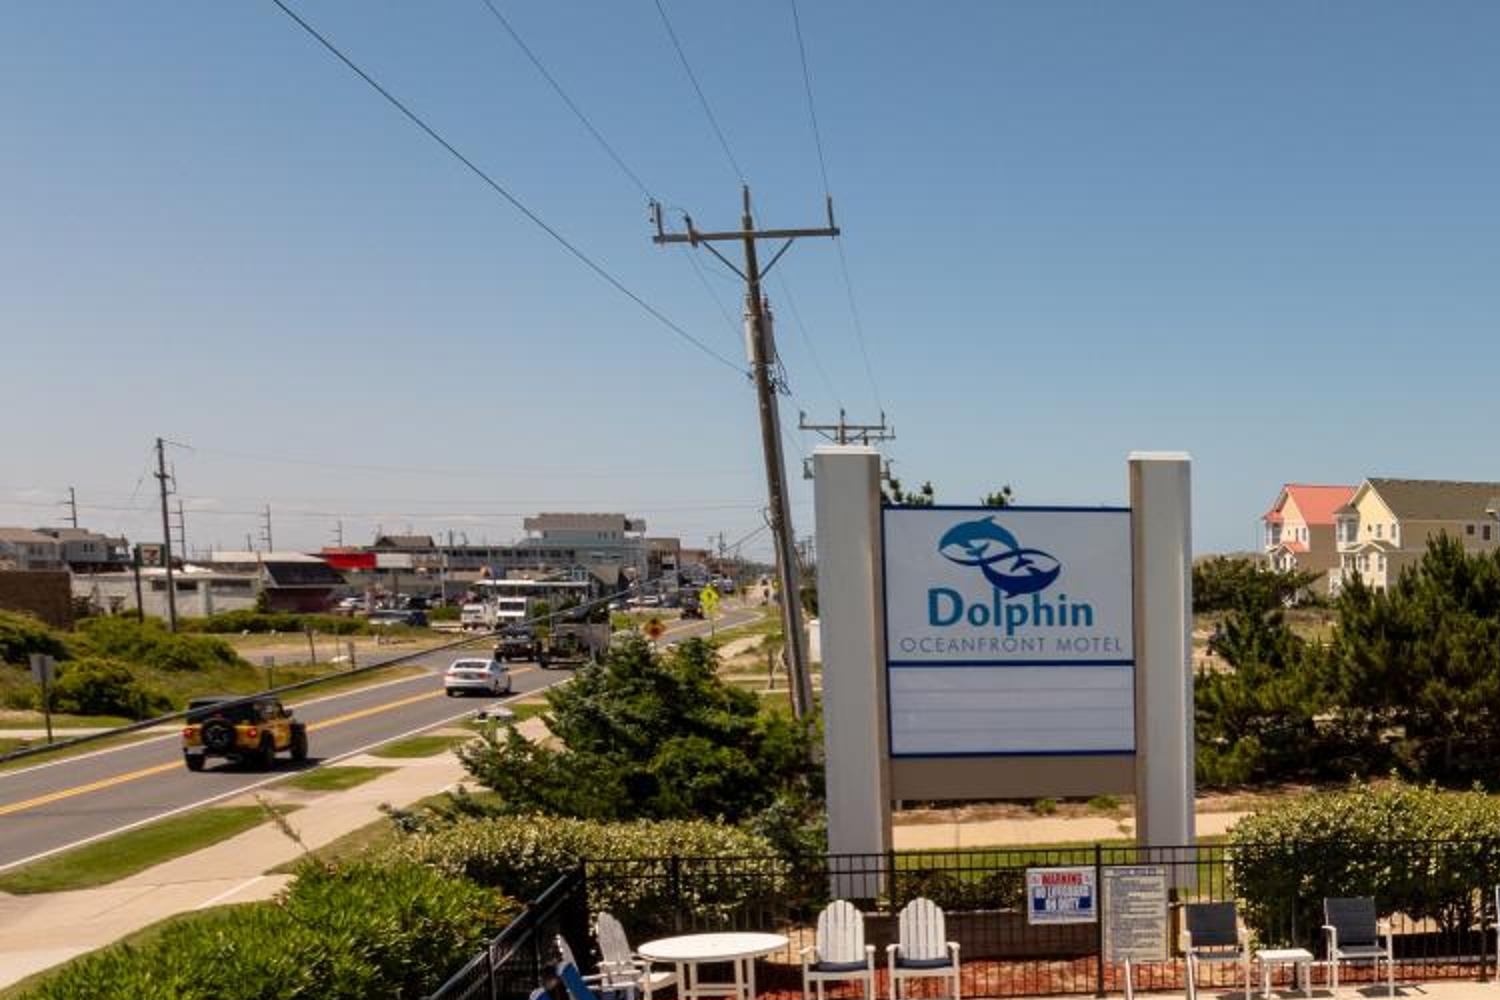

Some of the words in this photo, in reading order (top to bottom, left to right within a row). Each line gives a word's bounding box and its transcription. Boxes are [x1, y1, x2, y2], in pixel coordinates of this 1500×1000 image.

[928, 587, 1093, 636] Dolphin
[900, 637, 1045, 653] OCEANFRONT
[1056, 637, 1121, 652] MOTEL
